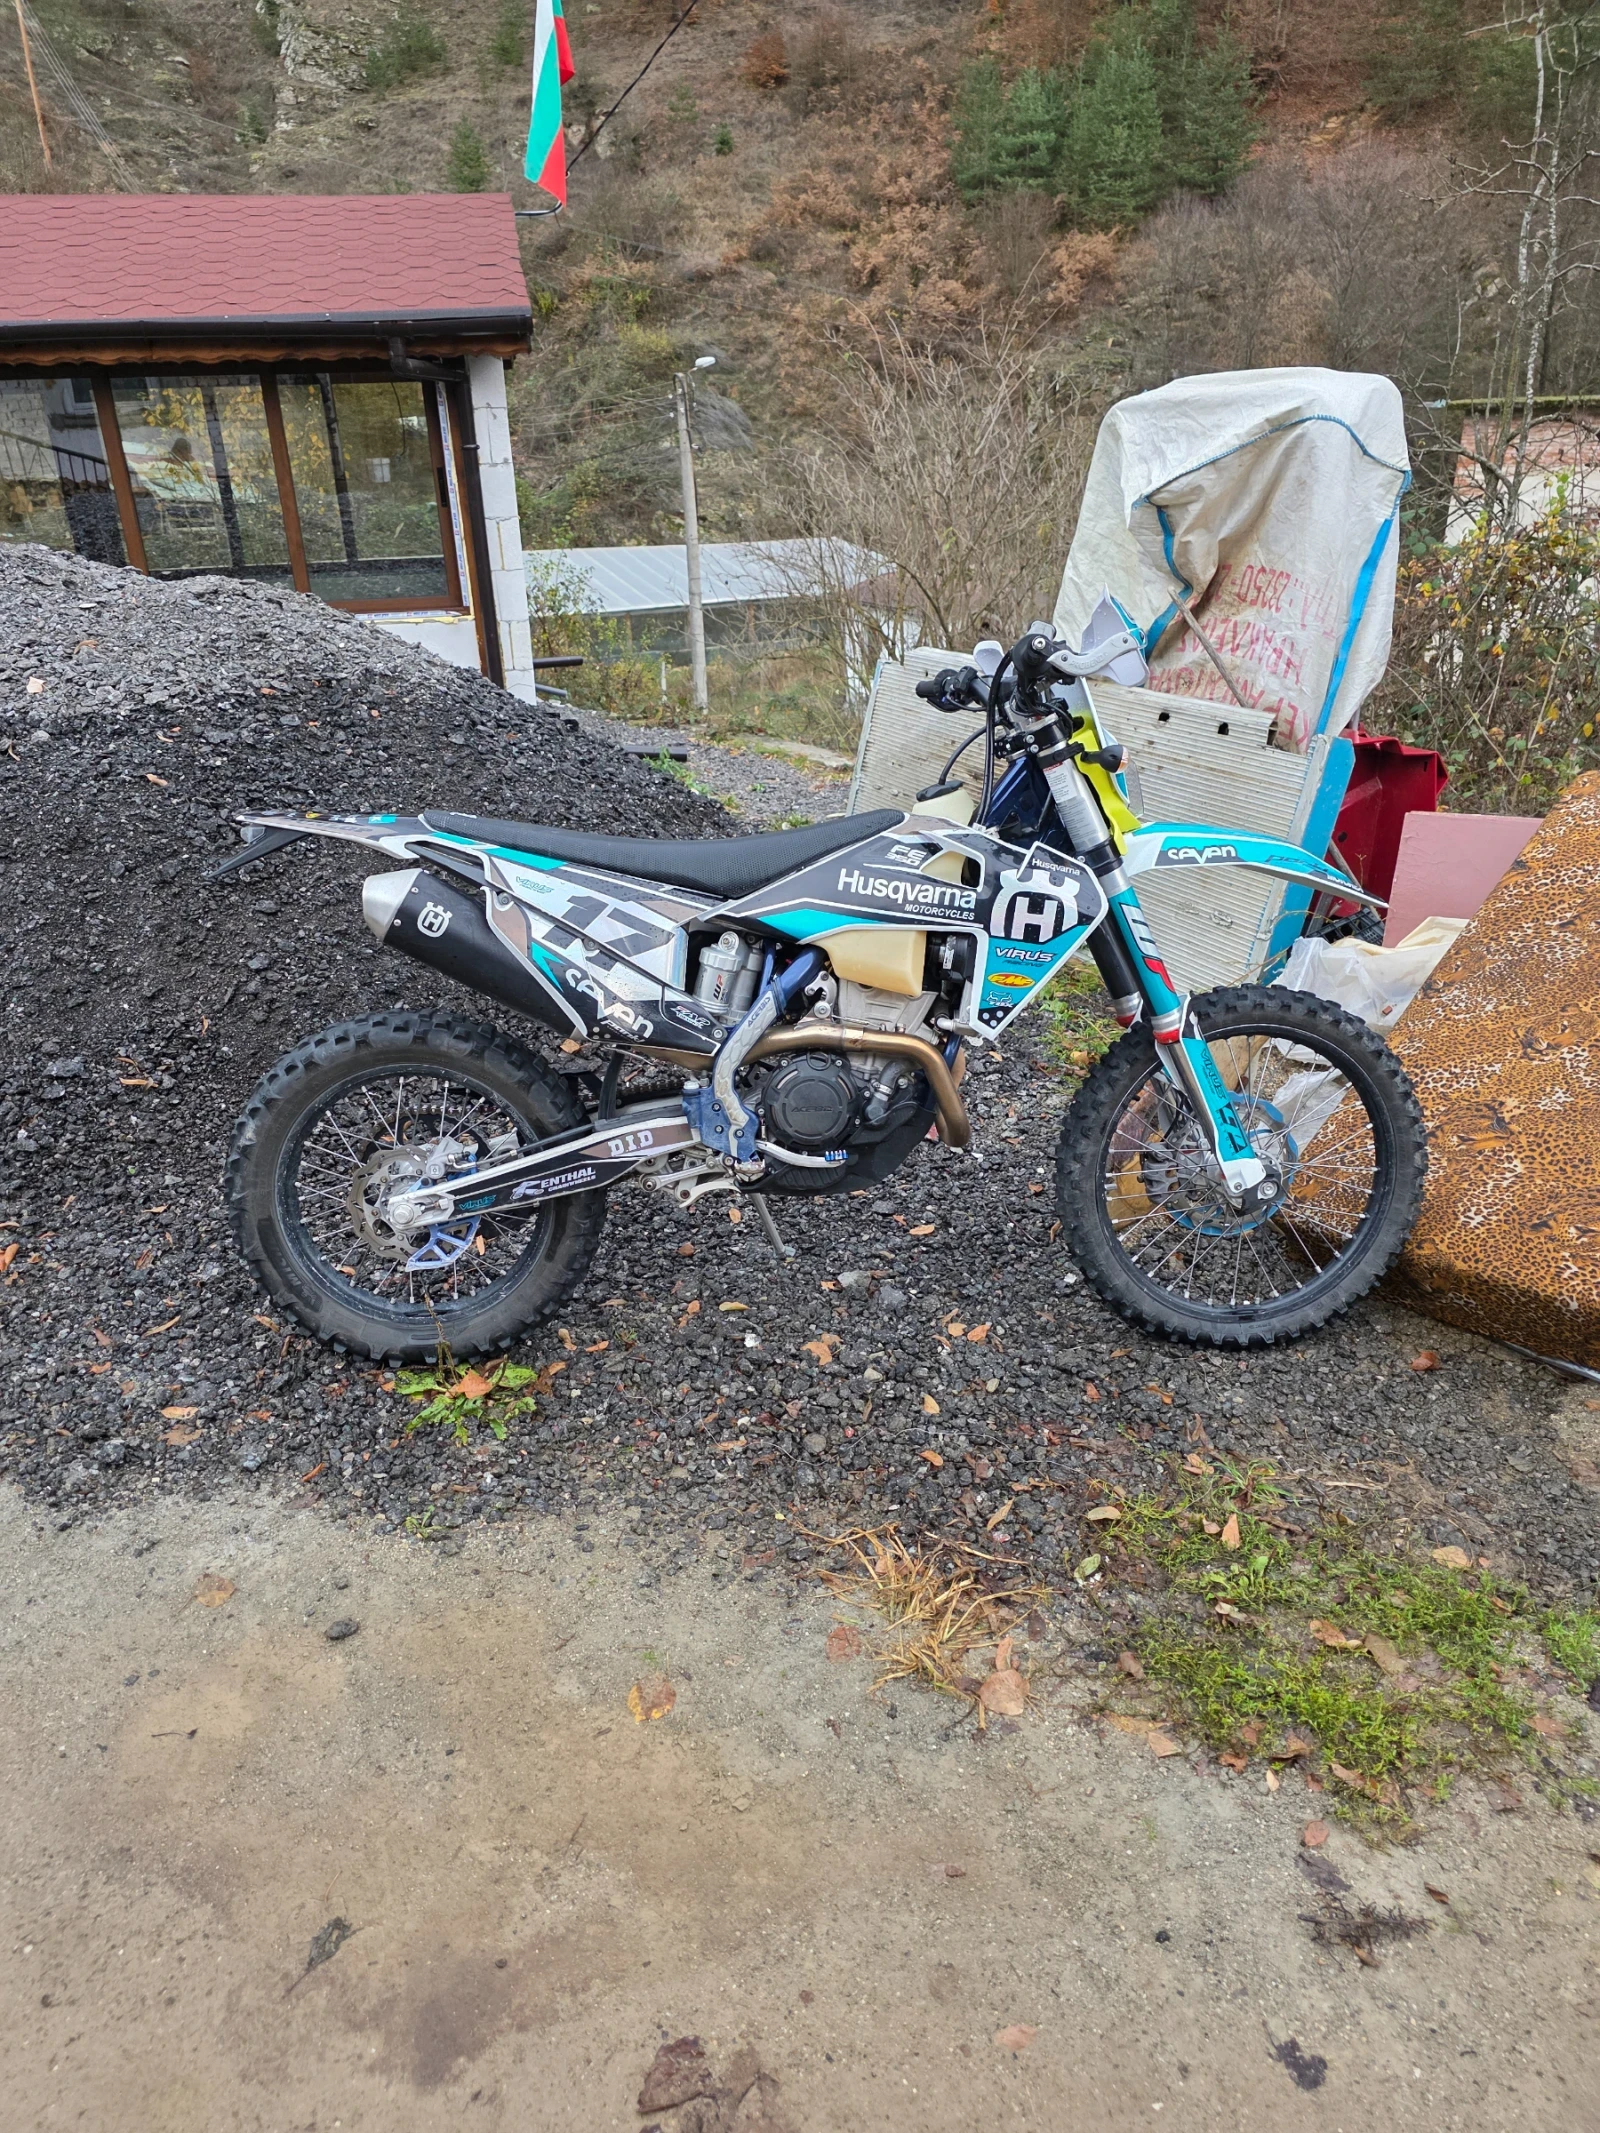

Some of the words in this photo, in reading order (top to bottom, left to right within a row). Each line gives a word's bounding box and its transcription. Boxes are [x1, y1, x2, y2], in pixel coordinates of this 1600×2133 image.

[890, 844, 927, 860] FE
[1031, 858, 1081, 876] Husqvarna
[837, 868, 977, 910] Husqvarna
[904, 903, 975, 921] MOTORCYCLES
[542, 895, 675, 972] 17
[996, 946, 1056, 962] VIRUS
[989, 974, 1034, 987] FMF
